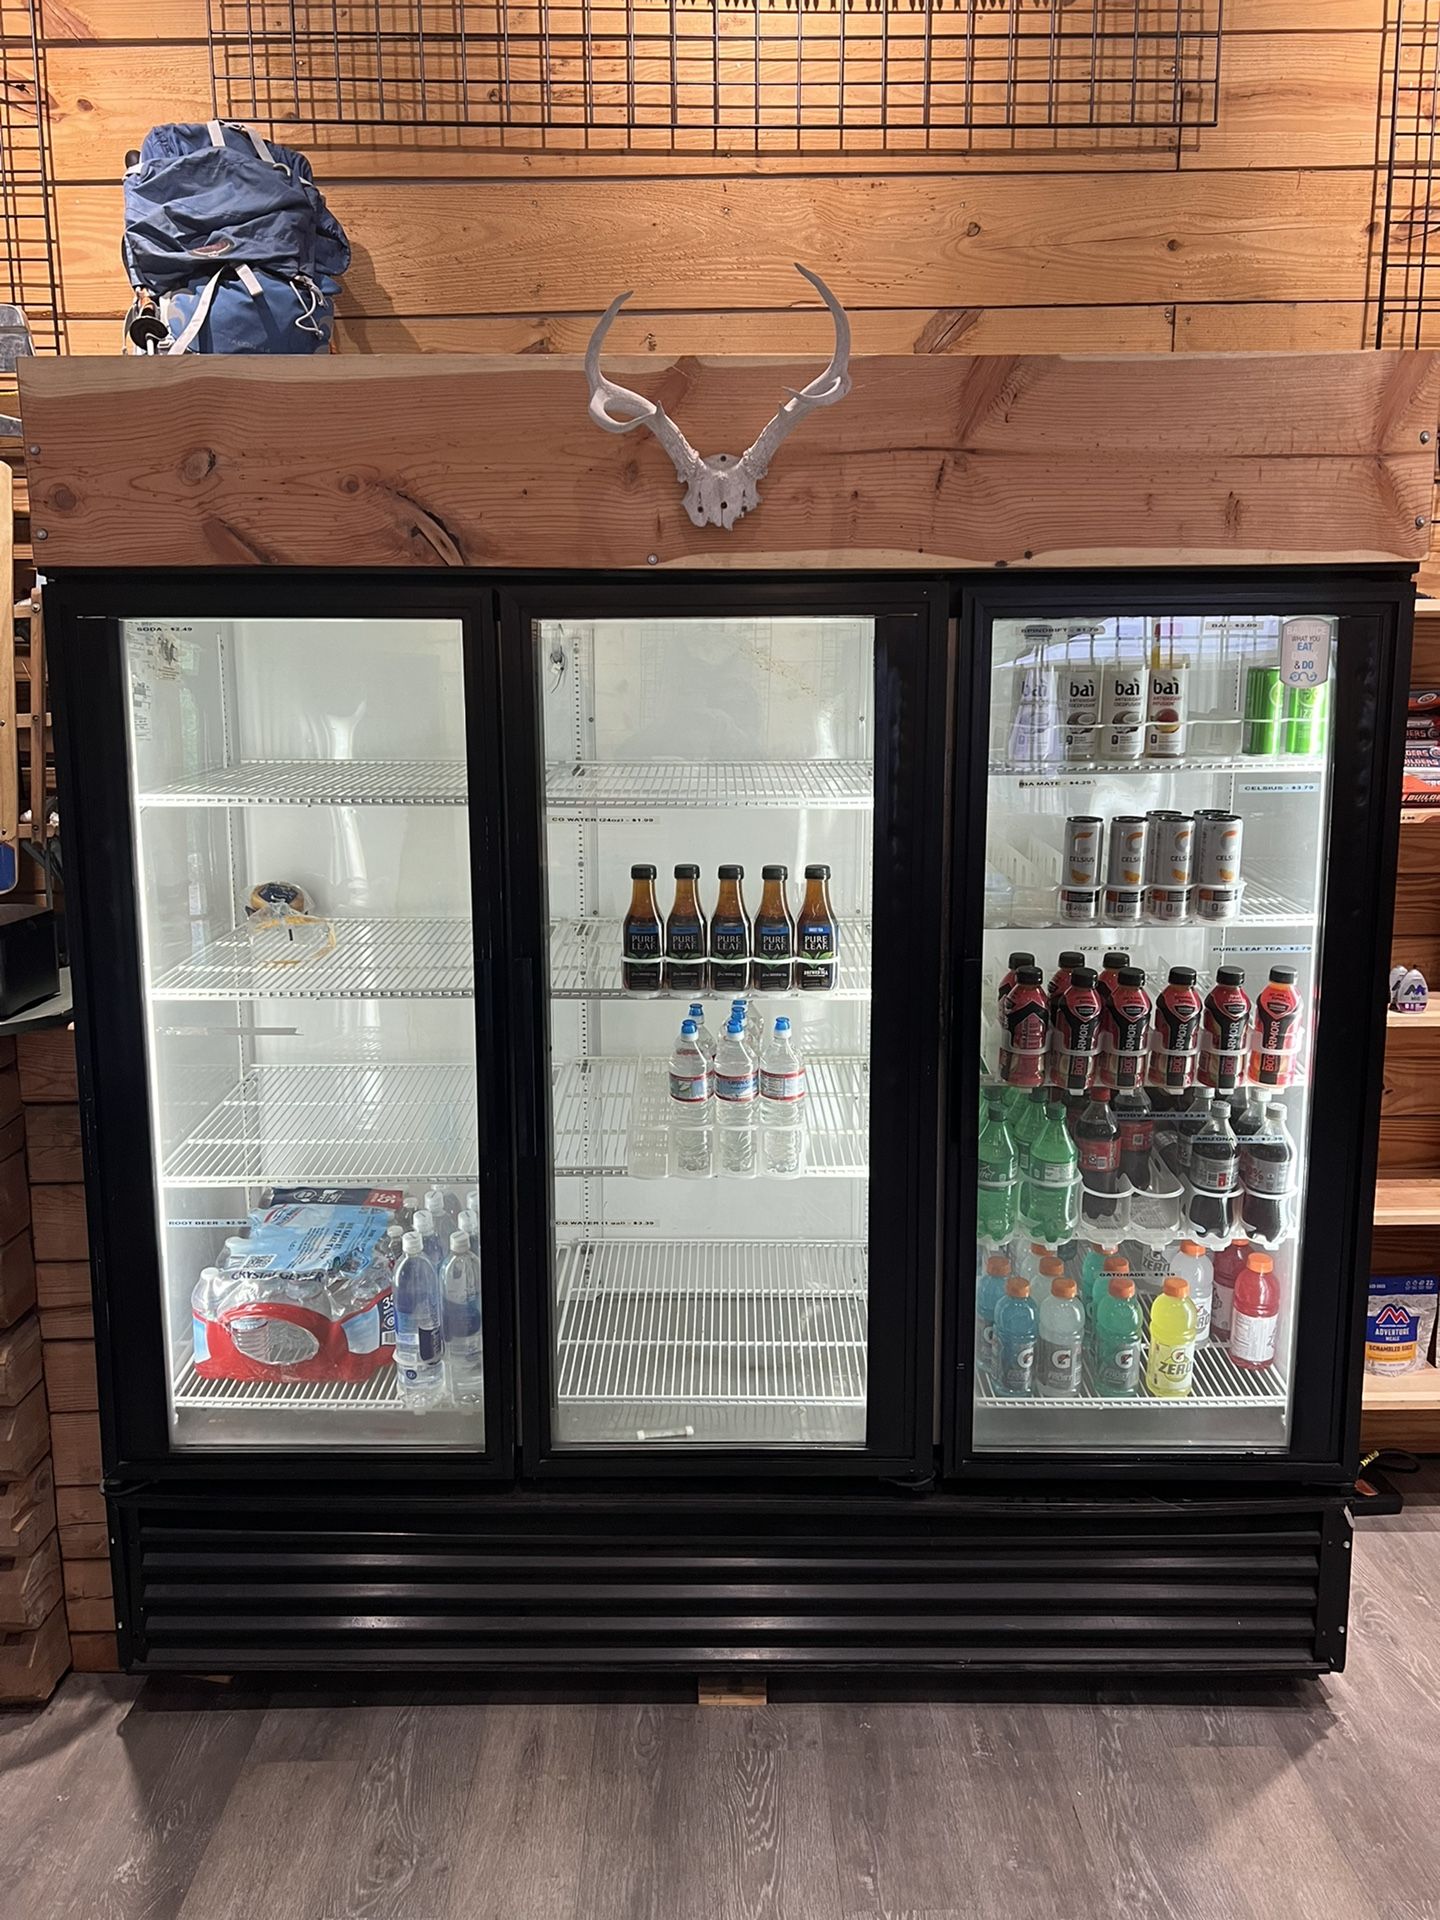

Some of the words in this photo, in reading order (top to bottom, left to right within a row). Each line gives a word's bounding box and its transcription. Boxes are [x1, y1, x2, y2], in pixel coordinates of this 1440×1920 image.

[1294, 660, 1301, 669] &
[1301, 661, 1314, 669] DO
[1070, 679, 1095, 697] bai
[1115, 678, 1140, 696] bai
[1153, 676, 1179, 695] bai
[631, 935, 656, 943] PURE
[672, 935, 697, 943] PURE
[717, 935, 741, 943] PURE
[763, 935, 787, 943] PURE
[804, 935, 828, 943] PURE
[1375, 1327, 1409, 1336] ADVENTURE
[1158, 1361, 1192, 1375] ZERO
